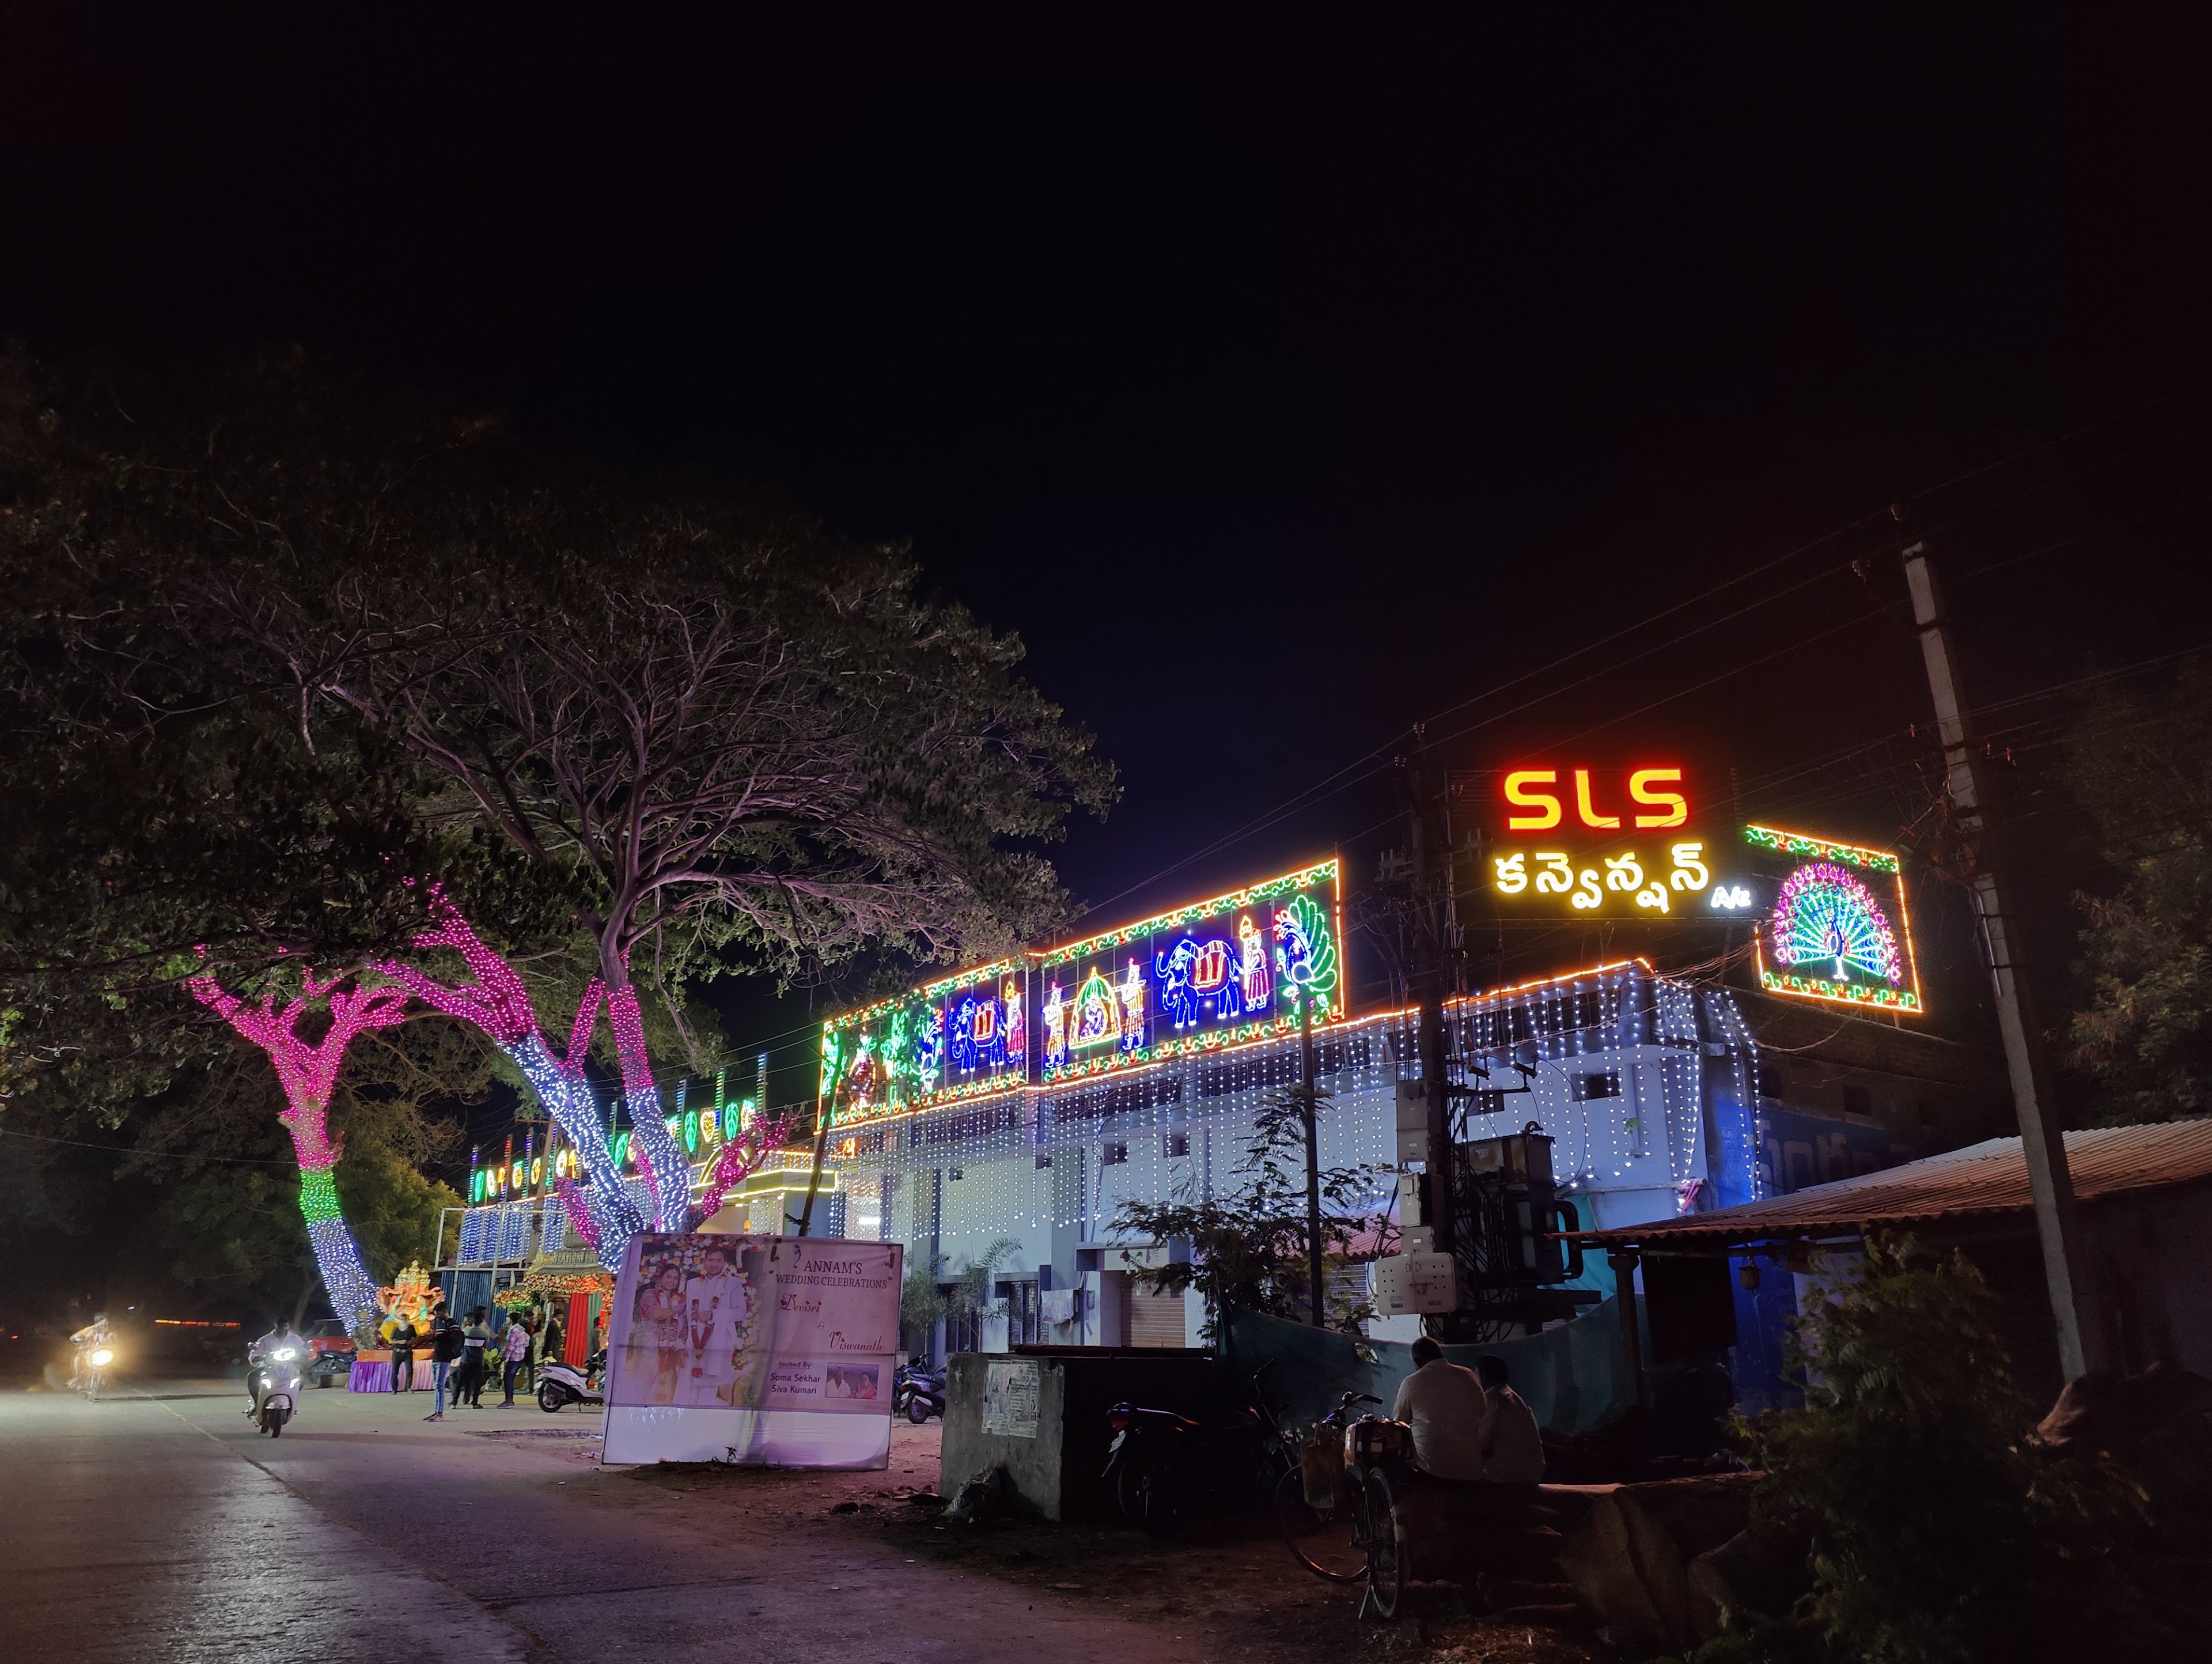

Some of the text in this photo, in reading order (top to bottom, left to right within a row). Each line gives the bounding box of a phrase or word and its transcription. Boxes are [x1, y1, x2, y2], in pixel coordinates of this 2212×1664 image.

[1505, 769, 1687, 829] SLS
[1495, 842, 1709, 913] కన్వెన్షన్
[776, 1274, 887, 1289] WEDDING CELEBRATIONS
[781, 1293, 822, 1313] Devisri
[829, 1331, 883, 1351] Viswanath
[770, 1372, 821, 1383] Soma Sekhar
[771, 1385, 817, 1394] Siva Kumari
